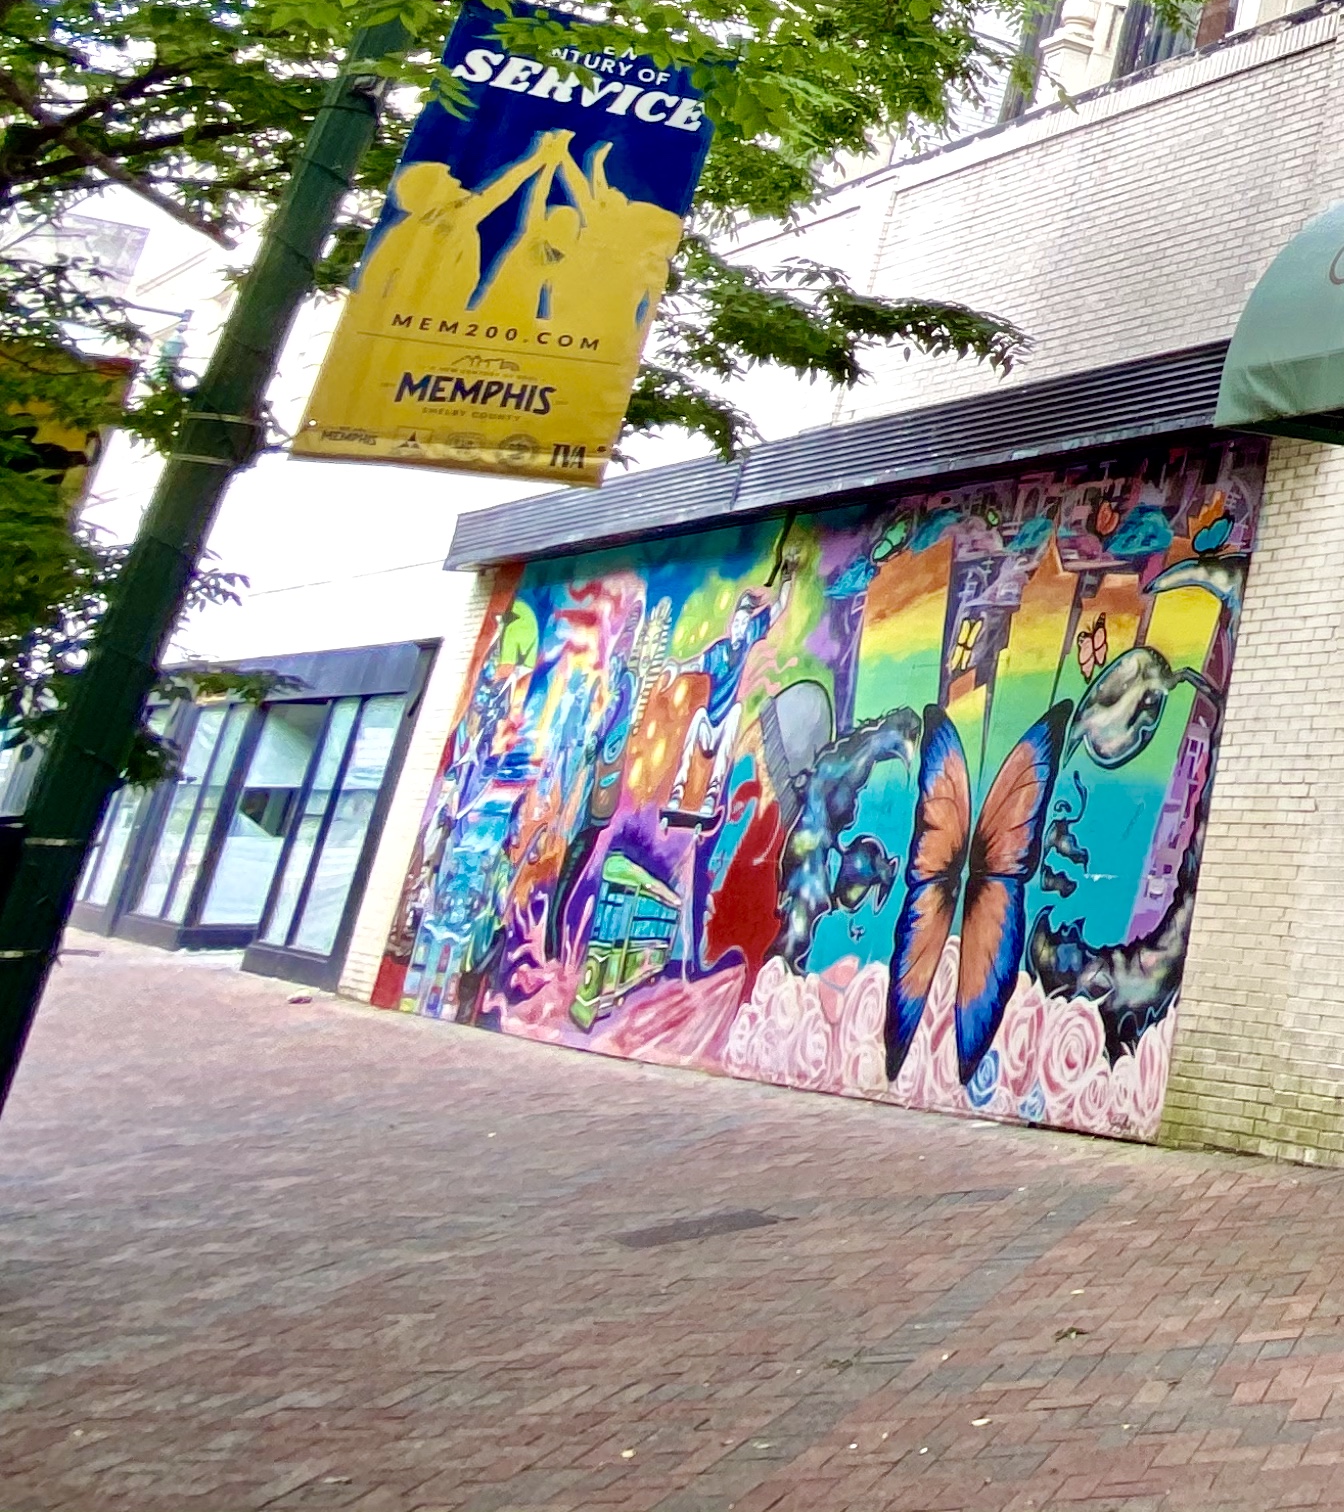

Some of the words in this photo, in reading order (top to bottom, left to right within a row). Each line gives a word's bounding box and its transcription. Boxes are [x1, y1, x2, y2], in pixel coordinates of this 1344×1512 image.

[451, 48, 706, 132] SERVICE
[637, 68, 671, 85] OF
[391, 313, 600, 351] MEM200.COM
[394, 372, 557, 416] MEMPHIS
